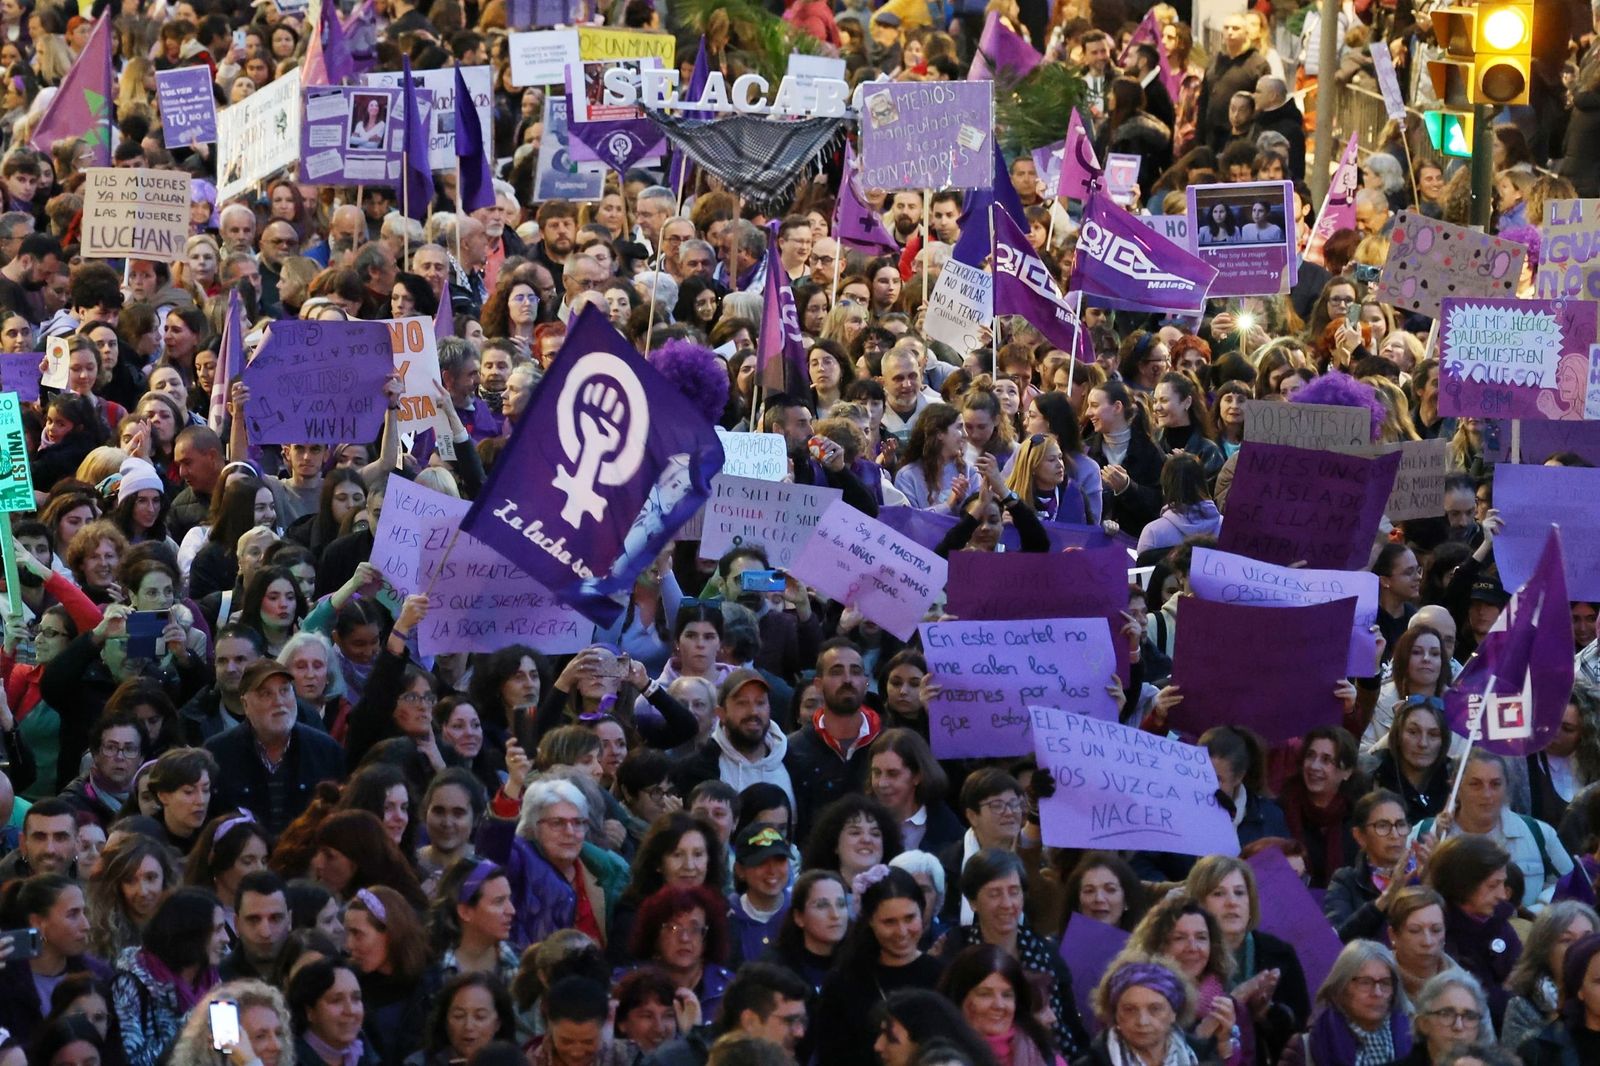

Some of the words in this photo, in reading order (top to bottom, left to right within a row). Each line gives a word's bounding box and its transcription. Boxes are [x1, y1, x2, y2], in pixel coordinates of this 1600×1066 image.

[605, 38, 624, 56] UN
[627, 39, 674, 60] MUNDO
[603, 67, 680, 109] SE
[896, 84, 956, 113] MEDIOS
[866, 148, 970, 188] CONTADORES
[94, 174, 117, 187] LAS
[125, 176, 186, 191] MUJERES
[97, 190, 114, 201] YA
[121, 191, 138, 201] NO
[145, 192, 185, 204] CALLAN
[94, 208, 117, 218] LAS
[125, 210, 182, 222] MUJERES
[1551, 200, 1583, 226] LA
[90, 226, 172, 253] LUCHAN
[1229, 252, 1240, 260] soy
[1248, 251, 1267, 260] mujer
[1251, 260, 1263, 268] soy
[944, 276, 957, 290] NO
[1147, 280, 1195, 292] Málaga
[1538, 265, 1583, 299] NO
[933, 291, 946, 306] NO
[947, 298, 954, 311] A
[957, 302, 985, 326] TENER
[1451, 312, 1480, 330] QUE
[1485, 314, 1508, 330] MIS
[1510, 316, 1555, 335] HECHOS
[1458, 346, 1545, 365] DEMUESTREN
[1514, 368, 1545, 386] SOY
[292, 398, 302, 413] A
[309, 398, 337, 413] VOY
[346, 396, 373, 413] HOY
[1247, 403, 1274, 433] YO
[1277, 405, 1364, 438] PROTESTO
[6, 429, 33, 509] PALESTINA
[752, 459, 781, 478] MUNDO
[1248, 450, 1278, 474] NO
[1279, 453, 1313, 476] ES
[1318, 460, 1350, 479] UN
[717, 483, 735, 498] NO
[1259, 481, 1368, 511] AISLADO
[1238, 503, 1263, 523] SE
[388, 524, 421, 548] MIS
[424, 526, 450, 550] EL
[493, 498, 524, 530] La
[522, 519, 573, 565] lucha
[743, 524, 757, 537] MI
[855, 521, 873, 543] Soy
[877, 533, 886, 547] la
[889, 542, 932, 576] MAESTRA
[384, 555, 408, 578] NO
[425, 562, 457, 580] LAS
[817, 528, 829, 541] de
[832, 534, 845, 549] las
[848, 542, 876, 566] NIÑAS
[899, 572, 930, 598] JAMÁS
[1201, 554, 1227, 577] LA
[1242, 567, 1346, 595] VIOLENCIA
[449, 593, 482, 611] QUE
[487, 591, 547, 610] SIEMPRE
[430, 620, 451, 641] LA
[456, 617, 497, 637] BOCA
[504, 616, 579, 639] ABIERTA
[927, 624, 954, 649] En
[961, 631, 996, 647] este
[1064, 631, 1088, 643] no
[934, 659, 964, 676] me
[971, 654, 1019, 676] caben
[1028, 655, 1059, 676] las
[935, 687, 1005, 704] razones
[1019, 685, 1048, 706] por
[1058, 675, 1091, 699] las
[940, 714, 971, 738] que
[991, 706, 1032, 738] estoy
[1033, 710, 1060, 731] EL
[1066, 714, 1208, 766] PATRIARCADO
[1045, 736, 1072, 755] ES
[1080, 741, 1105, 758] UN
[1115, 749, 1163, 770] JUEZ
[1174, 762, 1215, 785] QUE
[1099, 770, 1182, 802] JUZGA
[1091, 803, 1174, 832] NACER
